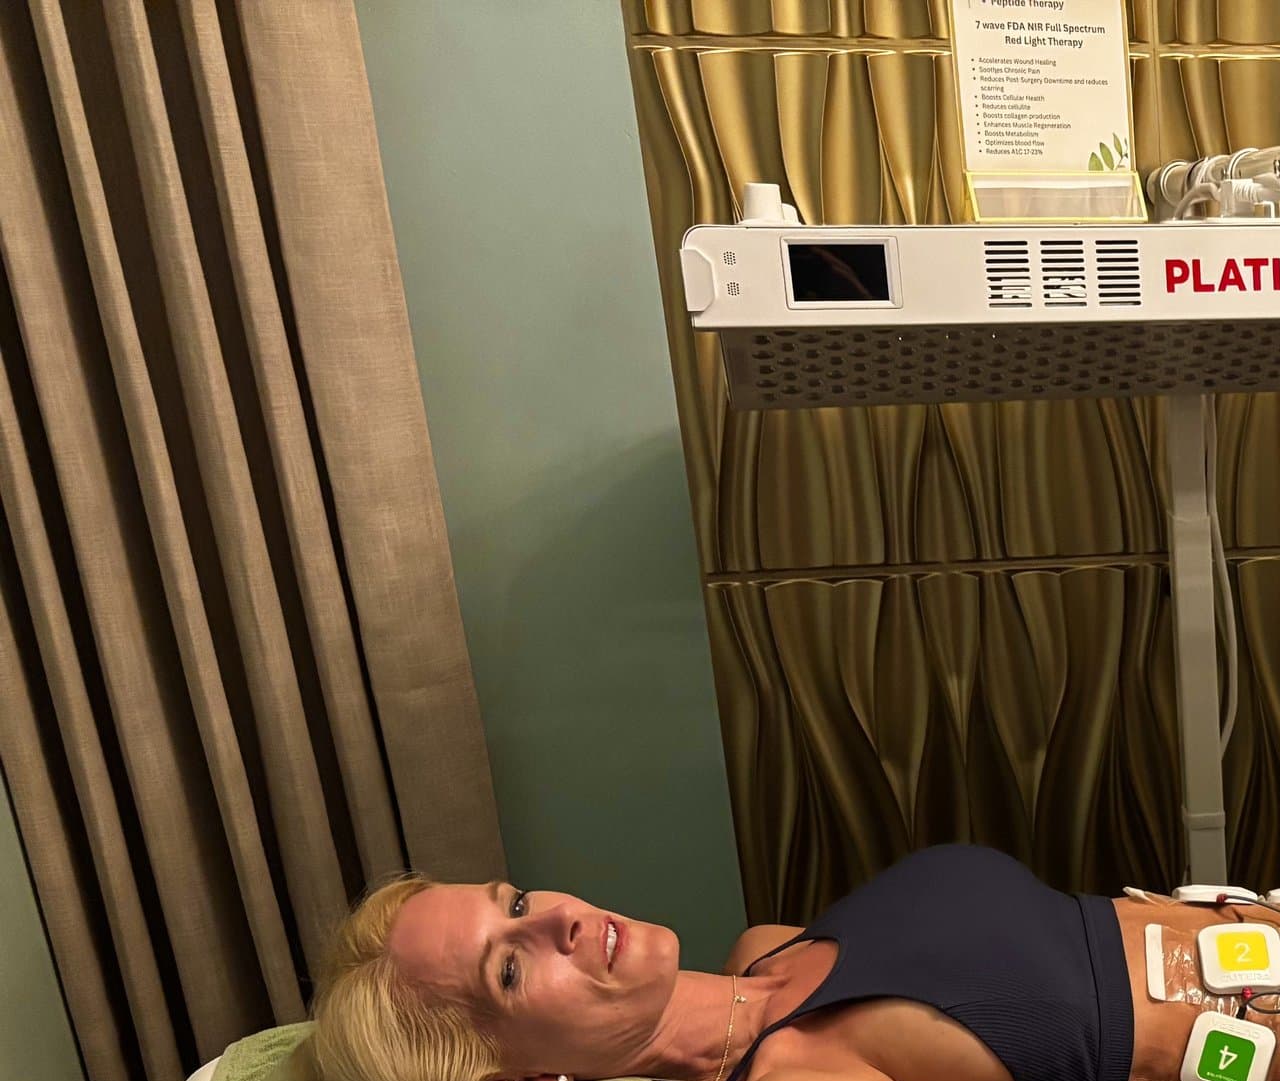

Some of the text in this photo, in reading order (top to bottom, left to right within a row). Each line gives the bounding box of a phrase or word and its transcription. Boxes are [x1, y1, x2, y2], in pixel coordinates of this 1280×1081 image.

[1028, 0, 1064, 10] Therapy
[975, 20, 1105, 34] 7 wave FDA NIR Full Spectrum
[1005, 35, 1083, 48] Red Light Therapy
[1234, 942, 1252, 962] 2
[1218, 1045, 1238, 1070] 4
